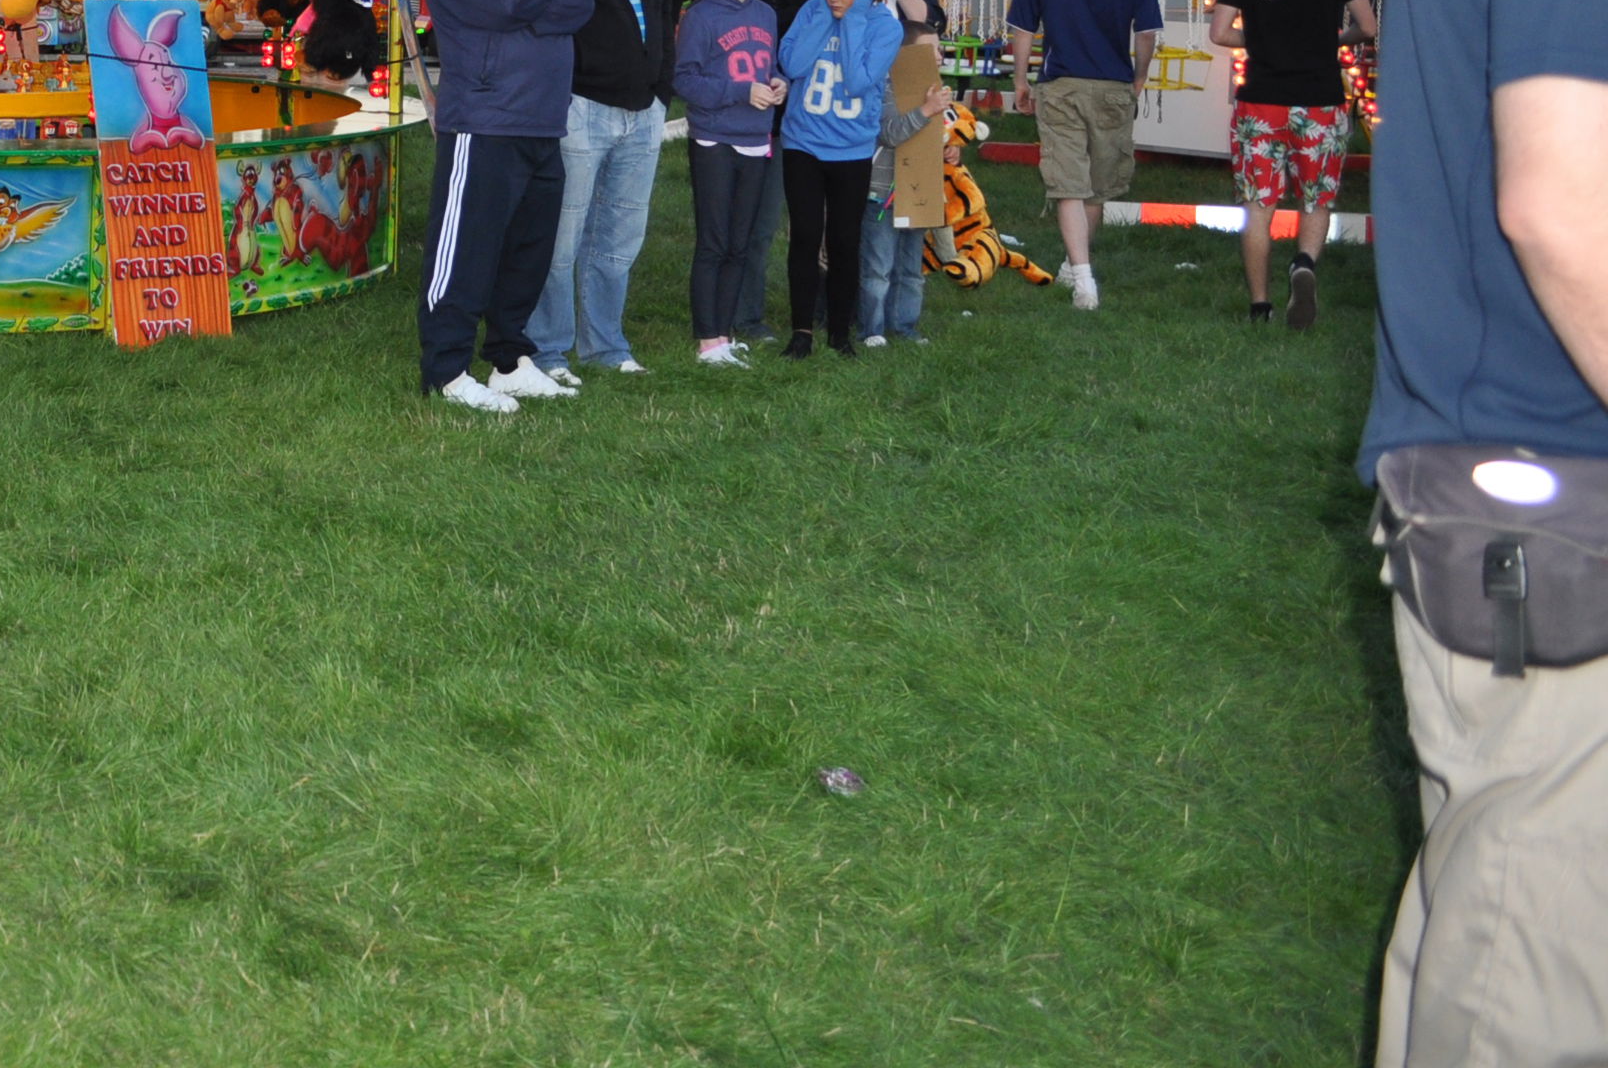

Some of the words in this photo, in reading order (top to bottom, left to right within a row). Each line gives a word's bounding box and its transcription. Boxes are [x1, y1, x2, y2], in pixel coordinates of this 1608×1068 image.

[106, 161, 192, 185] CATCH
[108, 192, 207, 217] WINNIE
[132, 224, 188, 248] AND
[115, 252, 225, 281] FRIENDS
[143, 287, 179, 310] TO
[139, 318, 192, 340] WIN
